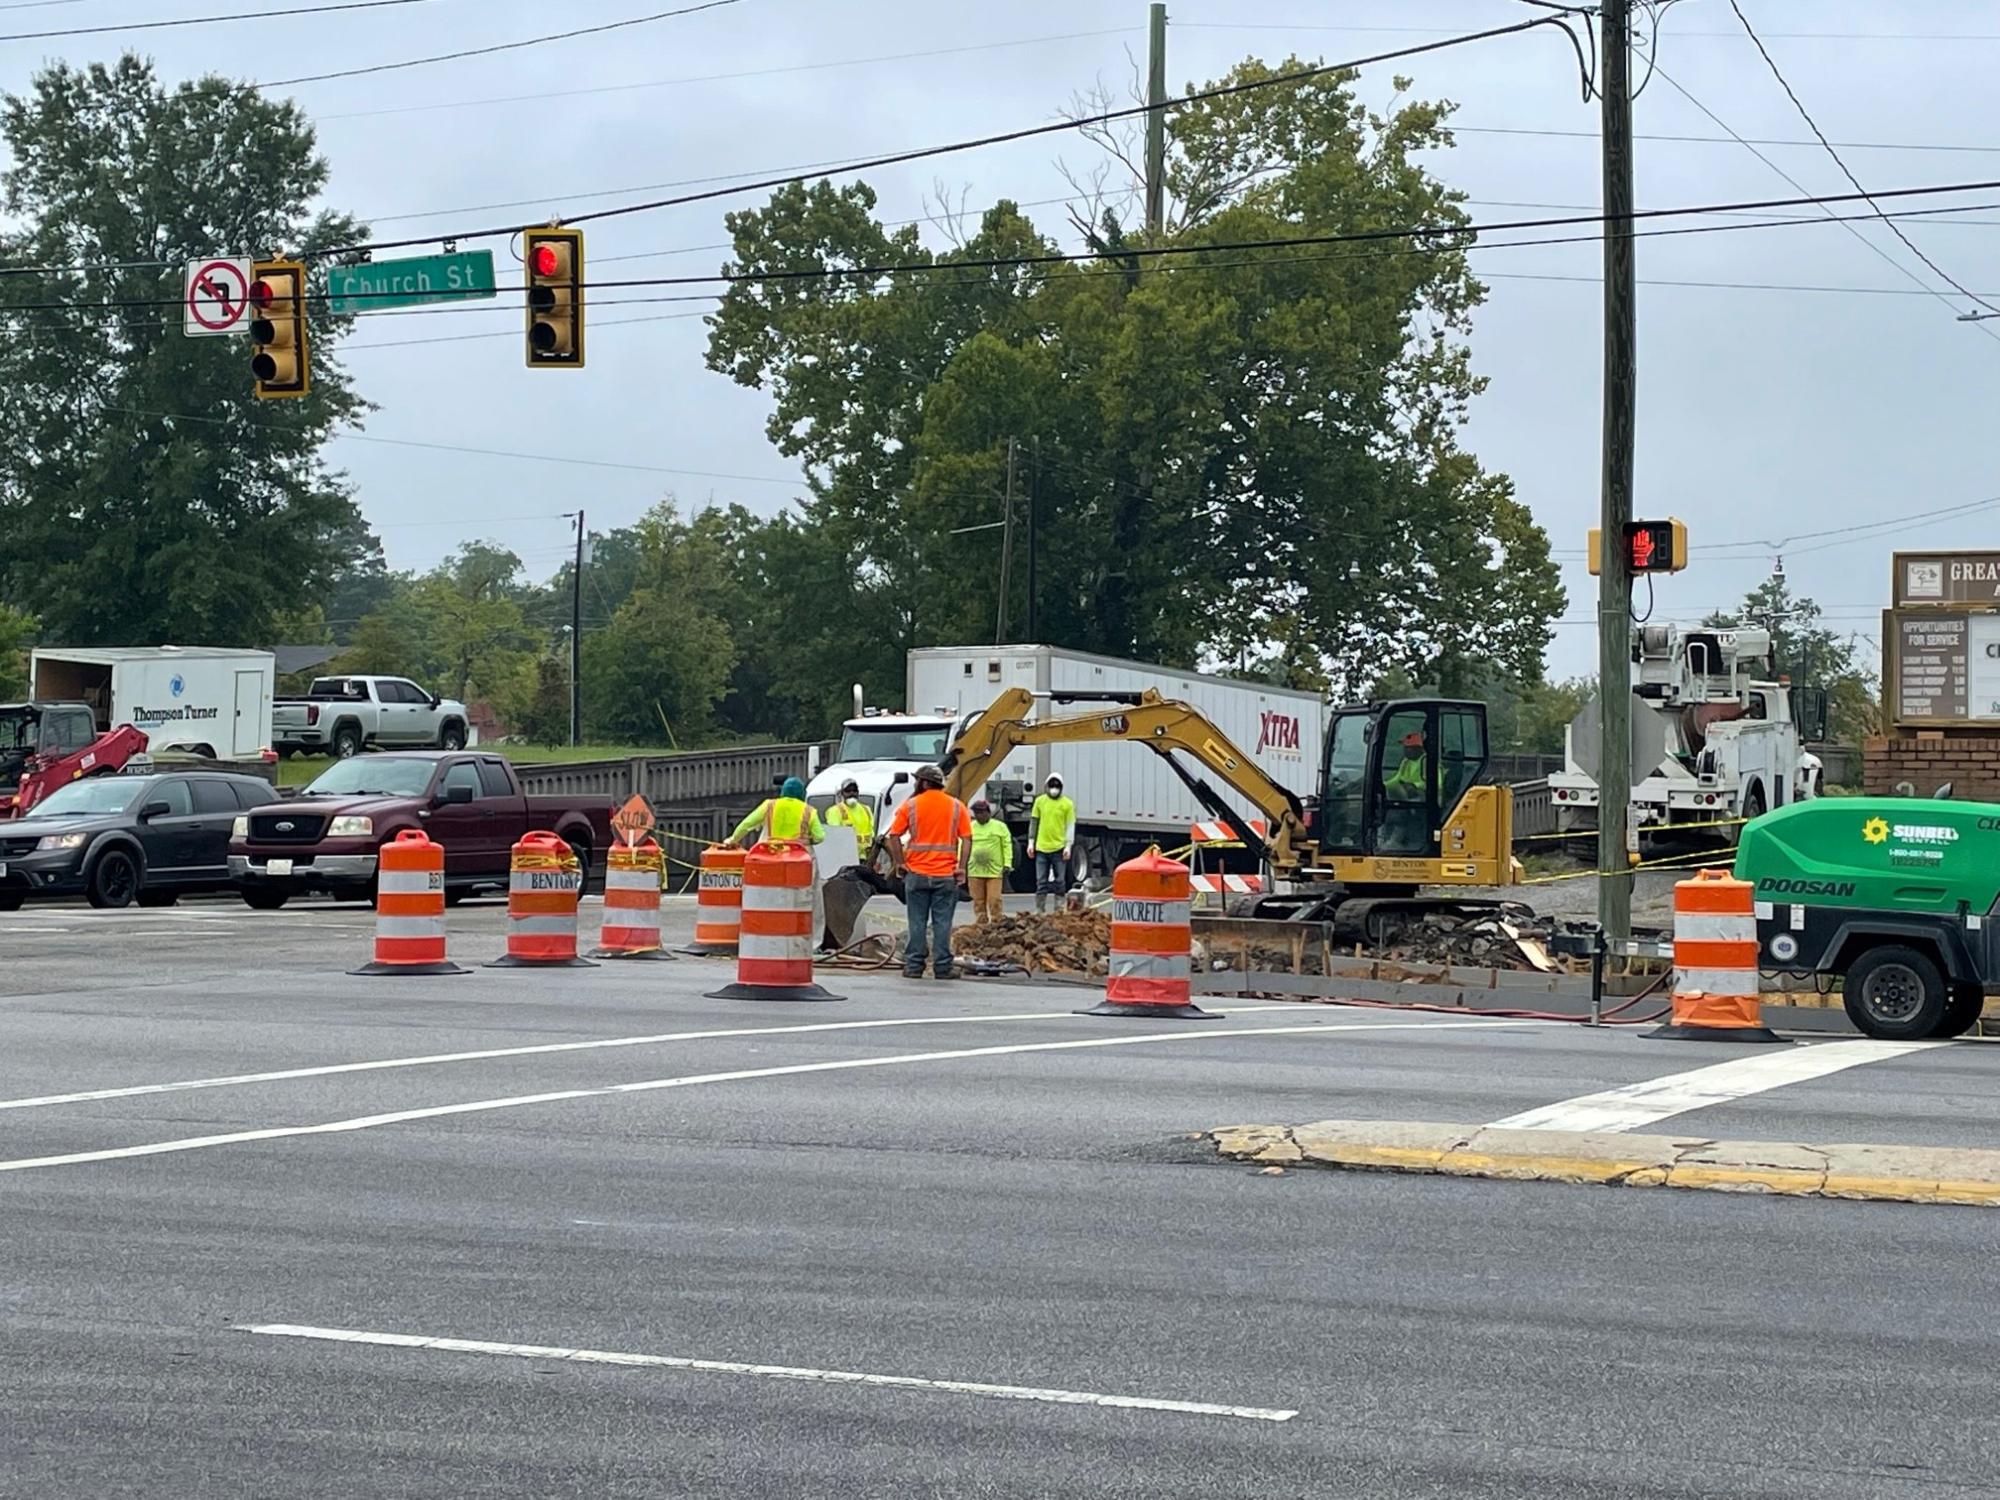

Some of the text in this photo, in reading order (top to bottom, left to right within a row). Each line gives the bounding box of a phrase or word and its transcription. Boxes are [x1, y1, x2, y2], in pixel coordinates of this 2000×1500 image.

[343, 264, 475, 296] Church St
[1950, 562, 2000, 581] GREA
[1908, 633, 1960, 646] FOR SERVICE
[133, 704, 218, 725] Thompson Turner
[1102, 715, 1124, 732] CAT
[1256, 710, 1299, 754] XTRA
[1758, 877, 1856, 897] DOOSAN
[1114, 900, 1164, 922] CONCRETE
